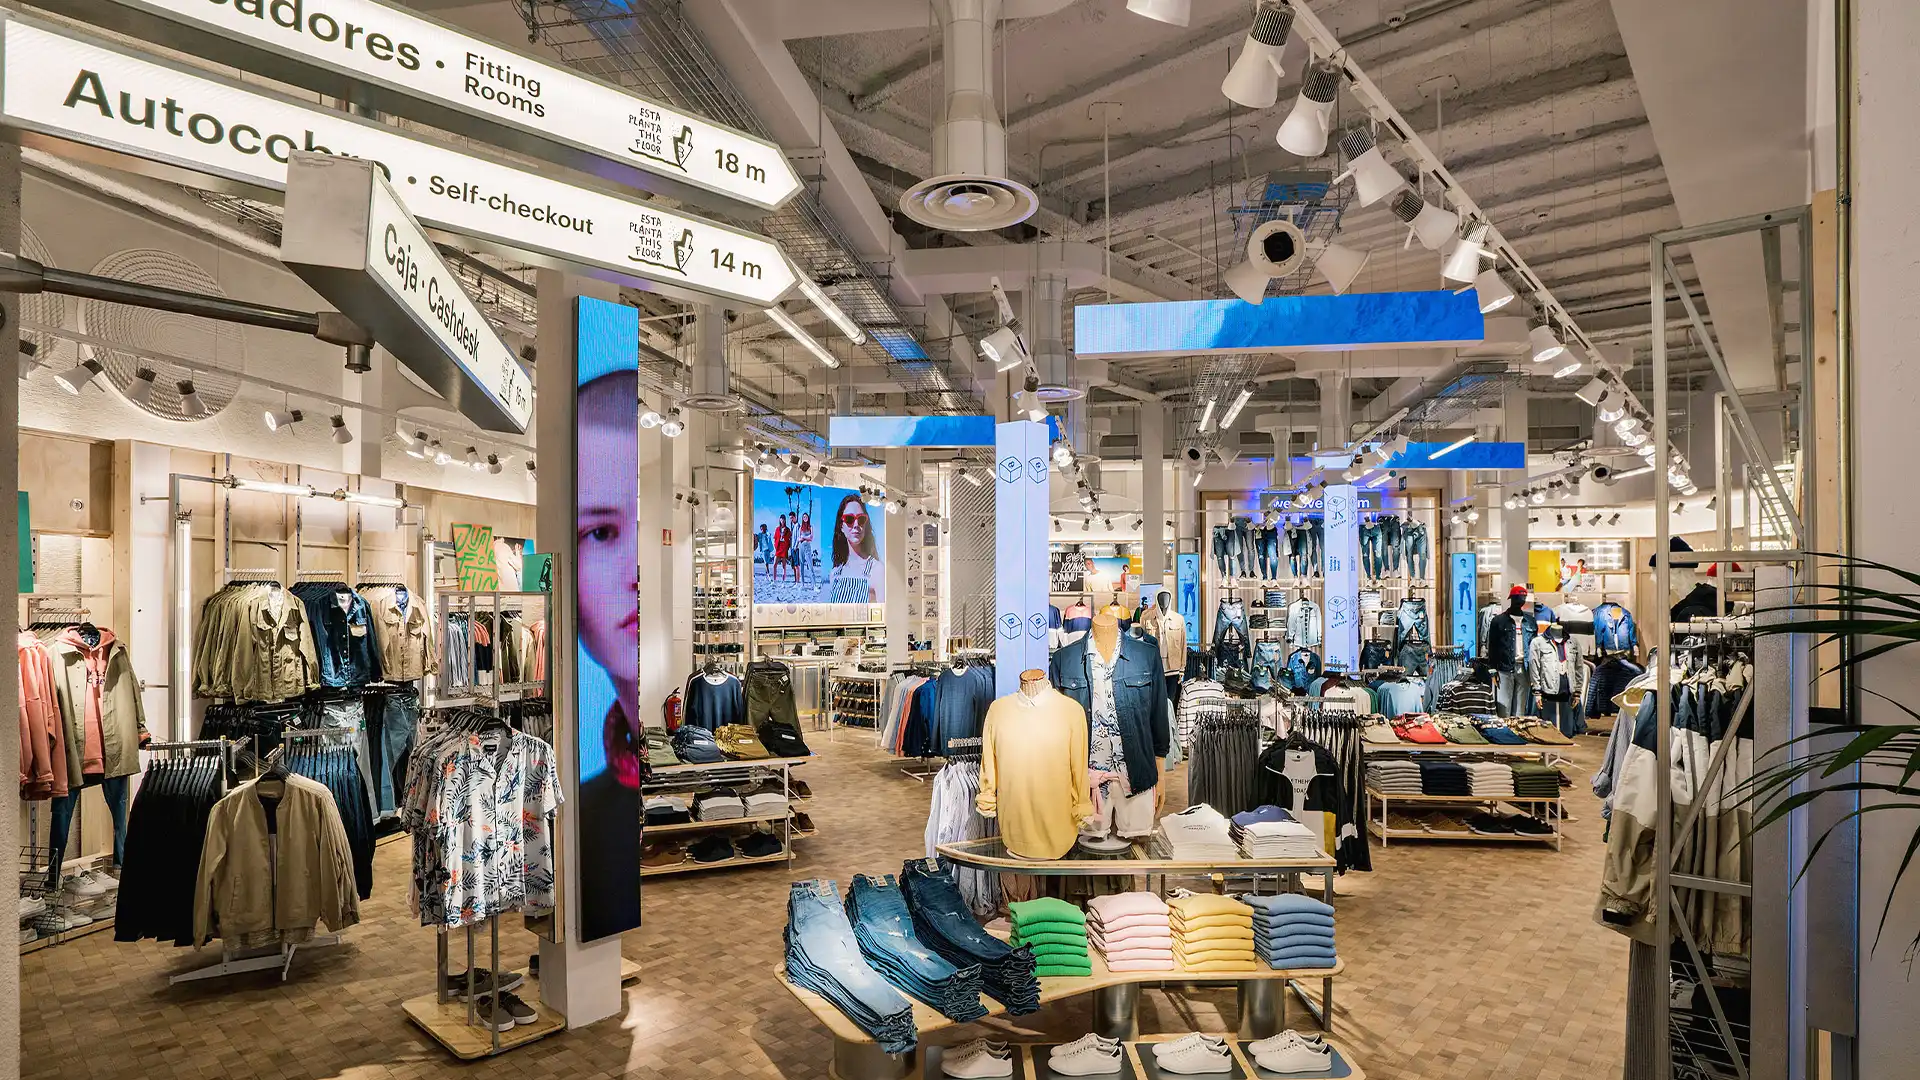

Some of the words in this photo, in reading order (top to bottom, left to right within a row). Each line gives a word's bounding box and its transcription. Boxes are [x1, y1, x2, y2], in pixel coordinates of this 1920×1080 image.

[208, 0, 421, 71] adores
[465, 51, 541, 98] Fitting
[464, 75, 546, 118] Rooms
[62, 68, 392, 184] Autoco
[629, 114, 662, 133] PLANTA
[640, 107, 661, 122] ESTA
[635, 138, 661, 155] FLOOR
[639, 129, 662, 145] THIS
[714, 148, 739, 174] 18
[746, 163, 766, 184] m
[429, 175, 594, 235] Self-checkout
[629, 221, 662, 239] PLANTA
[640, 214, 662, 227] ESTA
[635, 245, 661, 261] FLOOR
[639, 235, 662, 251] THIS
[710, 248, 736, 273] 14
[742, 261, 762, 280] m
[384, 222, 419, 293] Caja
[427, 276, 480, 363] Cashdesk
[457, 549, 497, 574] FOR
